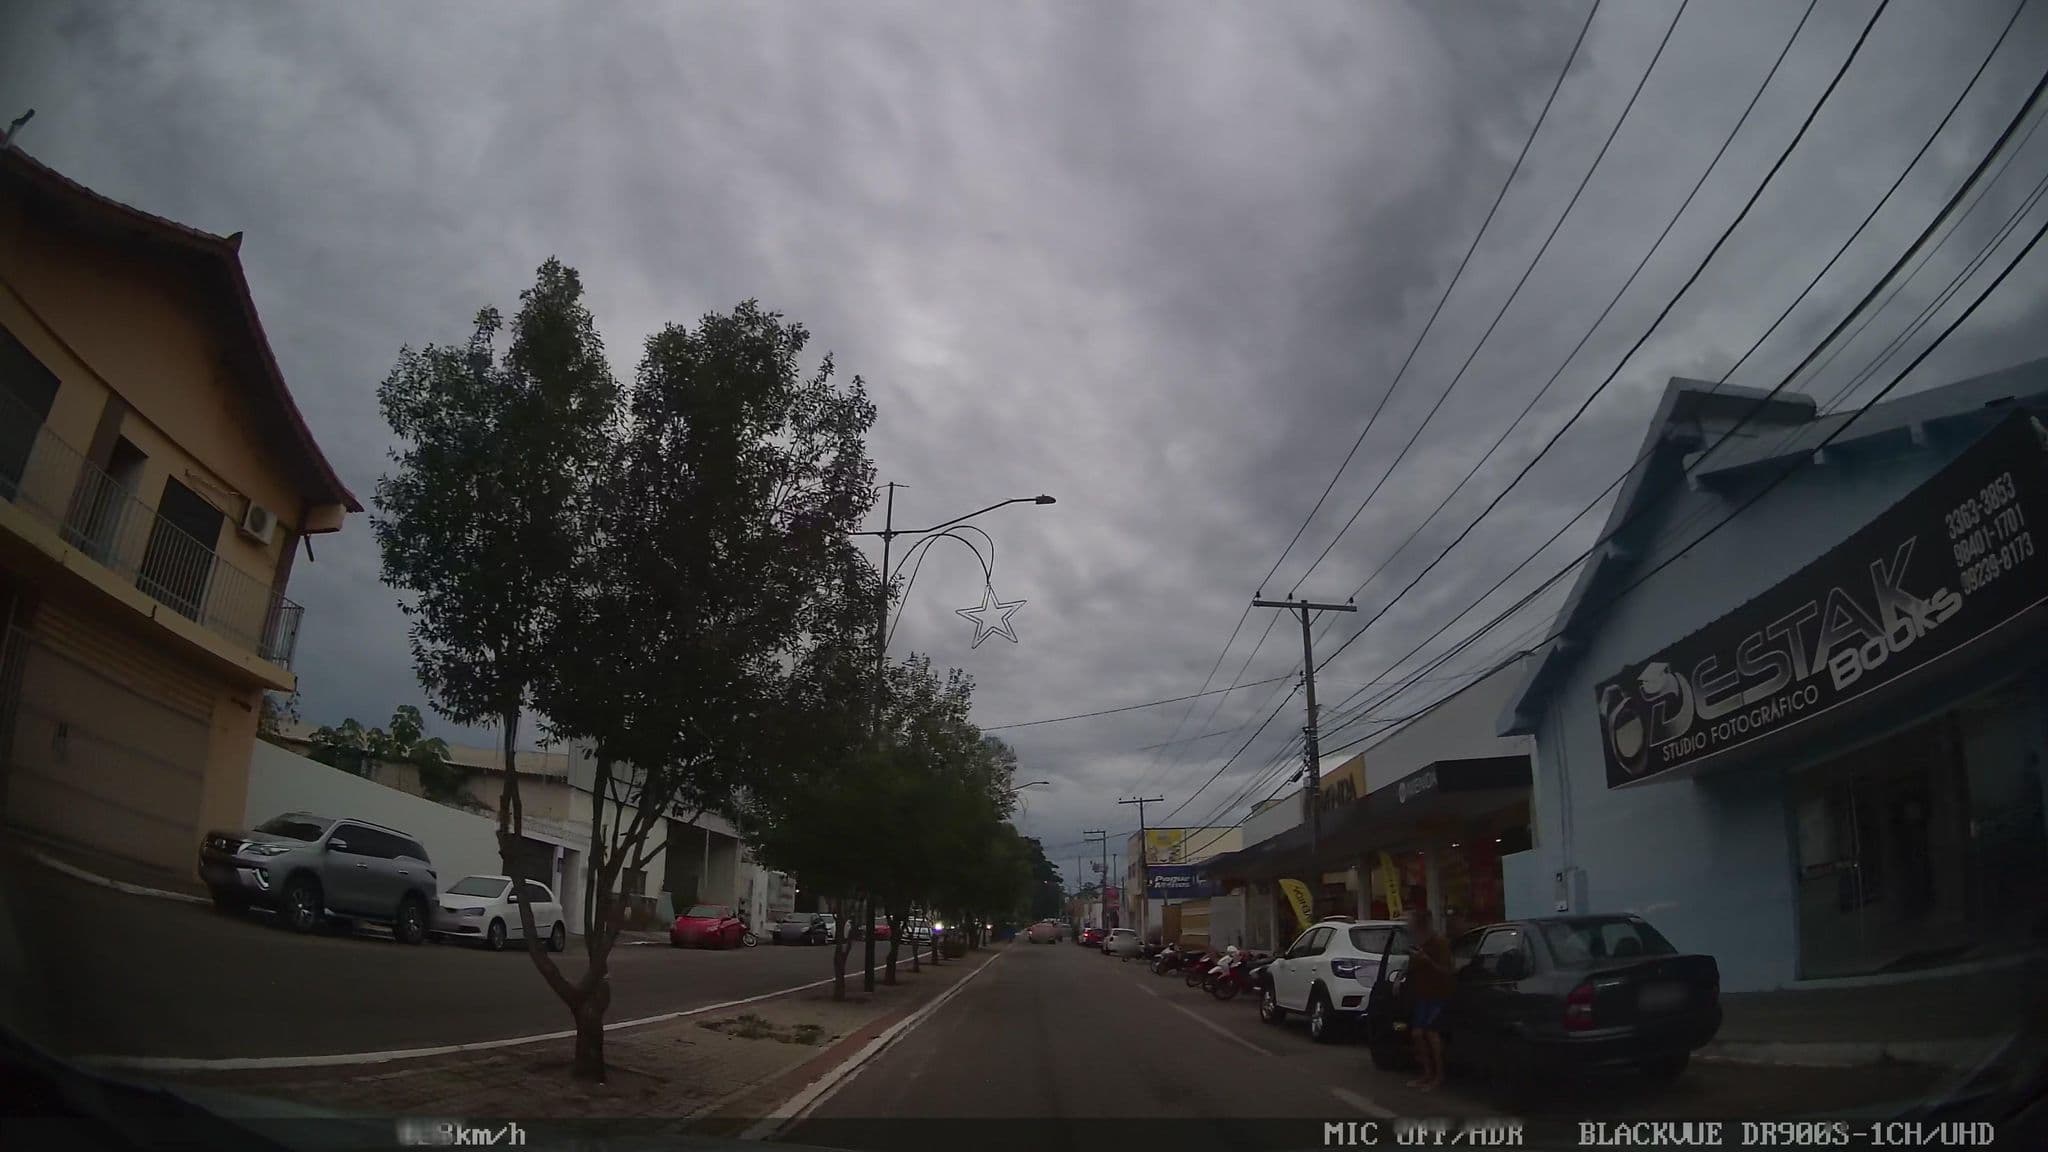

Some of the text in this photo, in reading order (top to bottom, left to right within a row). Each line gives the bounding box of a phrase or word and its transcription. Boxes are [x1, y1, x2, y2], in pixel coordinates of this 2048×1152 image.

[1945, 471, 2016, 539] 3363-3853
[1953, 503, 2025, 568] 98401-1701
[1649, 535, 1918, 748] DESTAK
[1662, 731, 1707, 763] STUDIO
